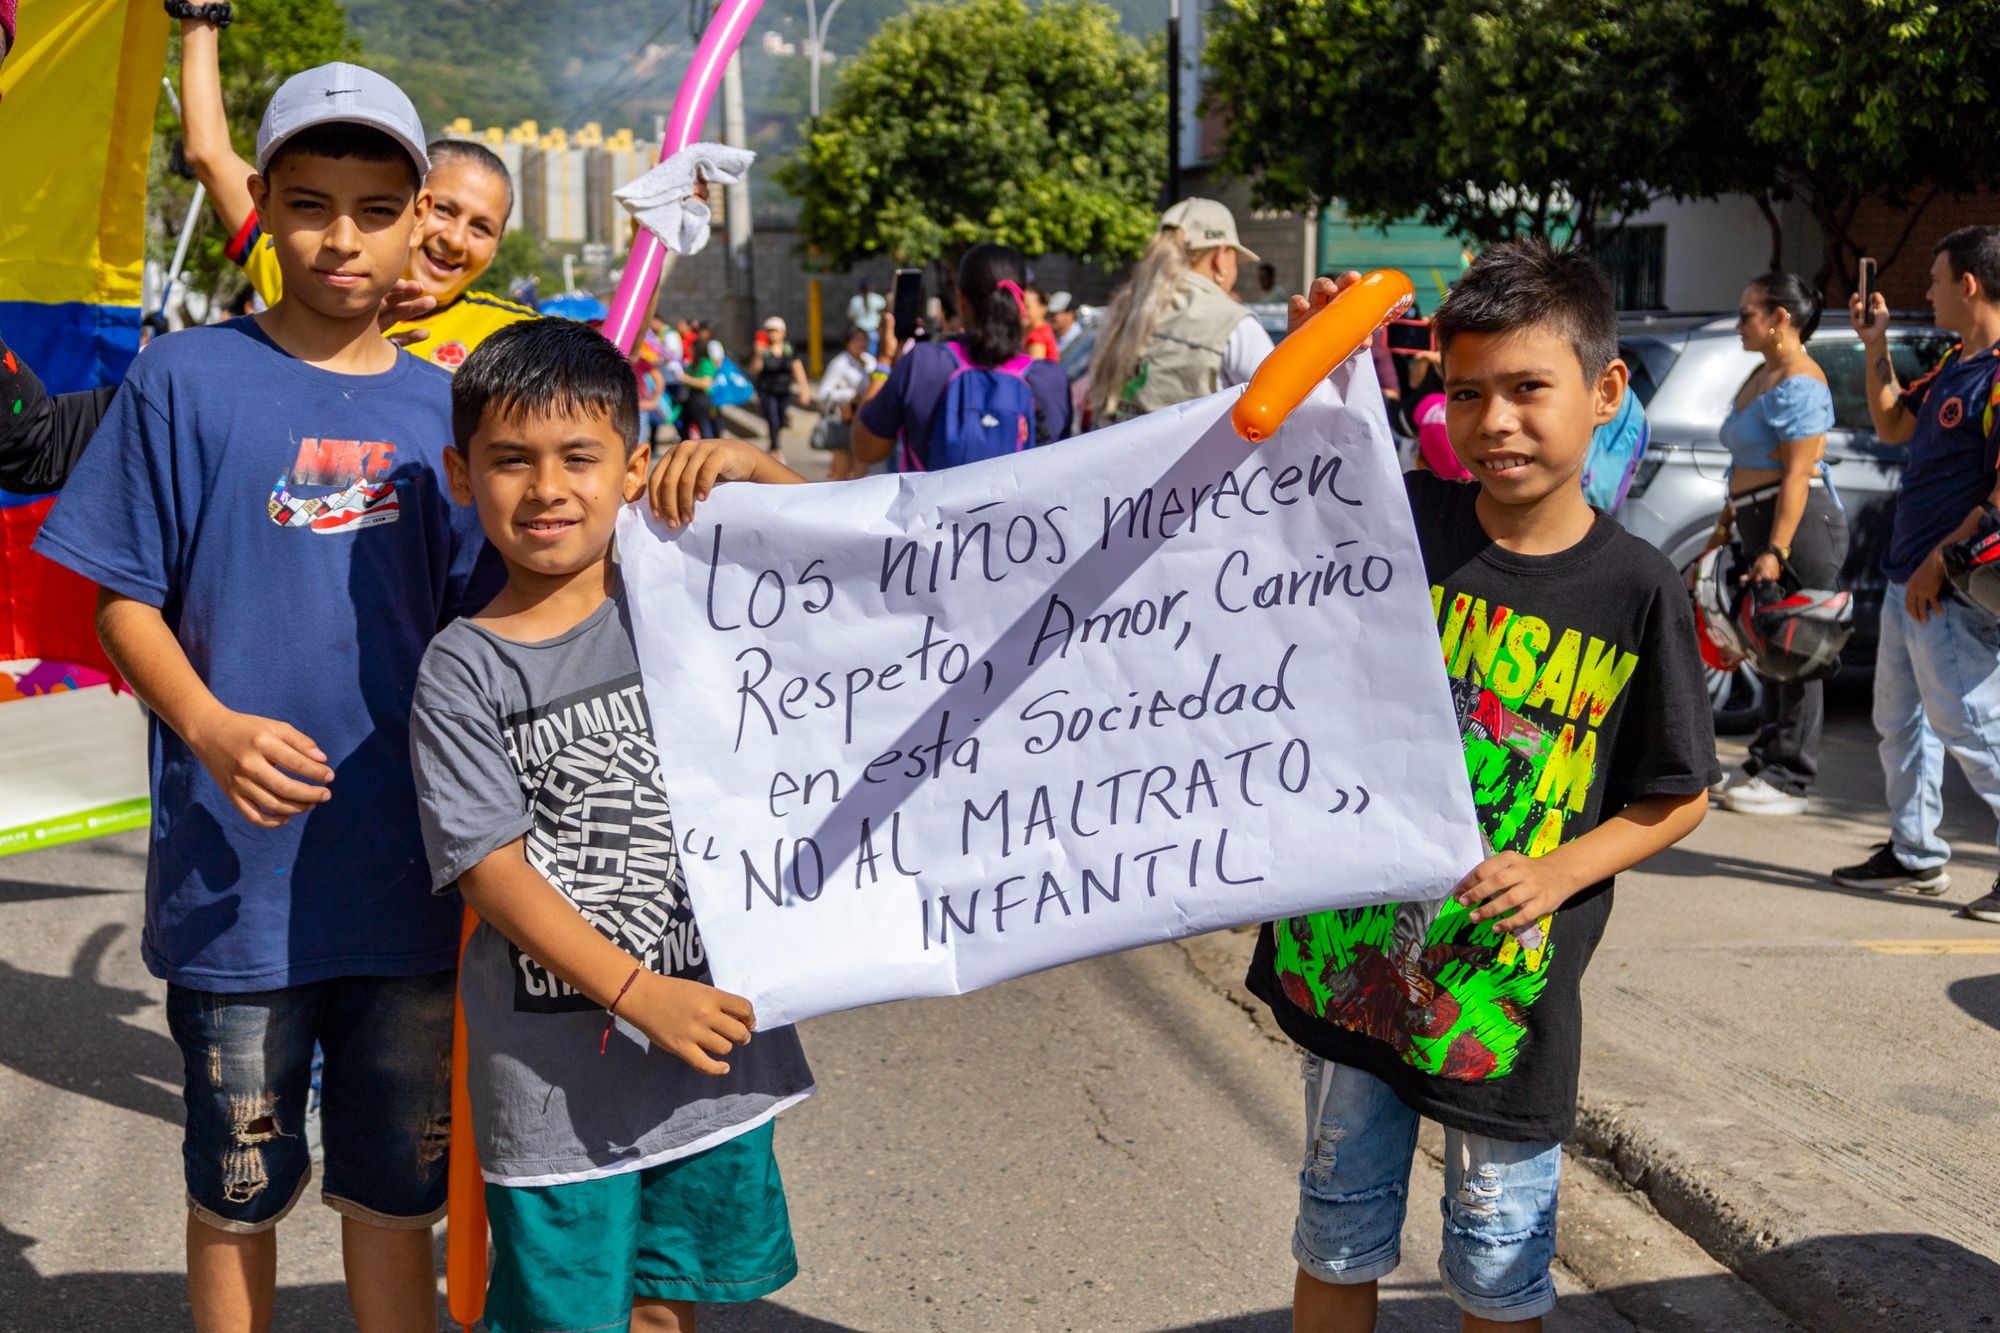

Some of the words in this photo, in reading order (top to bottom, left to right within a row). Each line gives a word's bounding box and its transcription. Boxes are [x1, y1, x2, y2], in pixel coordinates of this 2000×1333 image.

[289, 437, 397, 488] NIKE
[705, 523, 835, 631] Los
[879, 501, 1068, 596] niños
[1101, 454, 1363, 550] merecen
[734, 615, 994, 754] Respeto,
[1027, 590, 1192, 666] Amor,
[1214, 541, 1393, 613] Cariño
[1430, 584, 1640, 728] INSAW
[769, 768, 842, 817] en
[1019, 643, 1299, 755] Sociedad
[855, 811, 922, 890] AL
[922, 828, 1265, 950] INFANTIL
